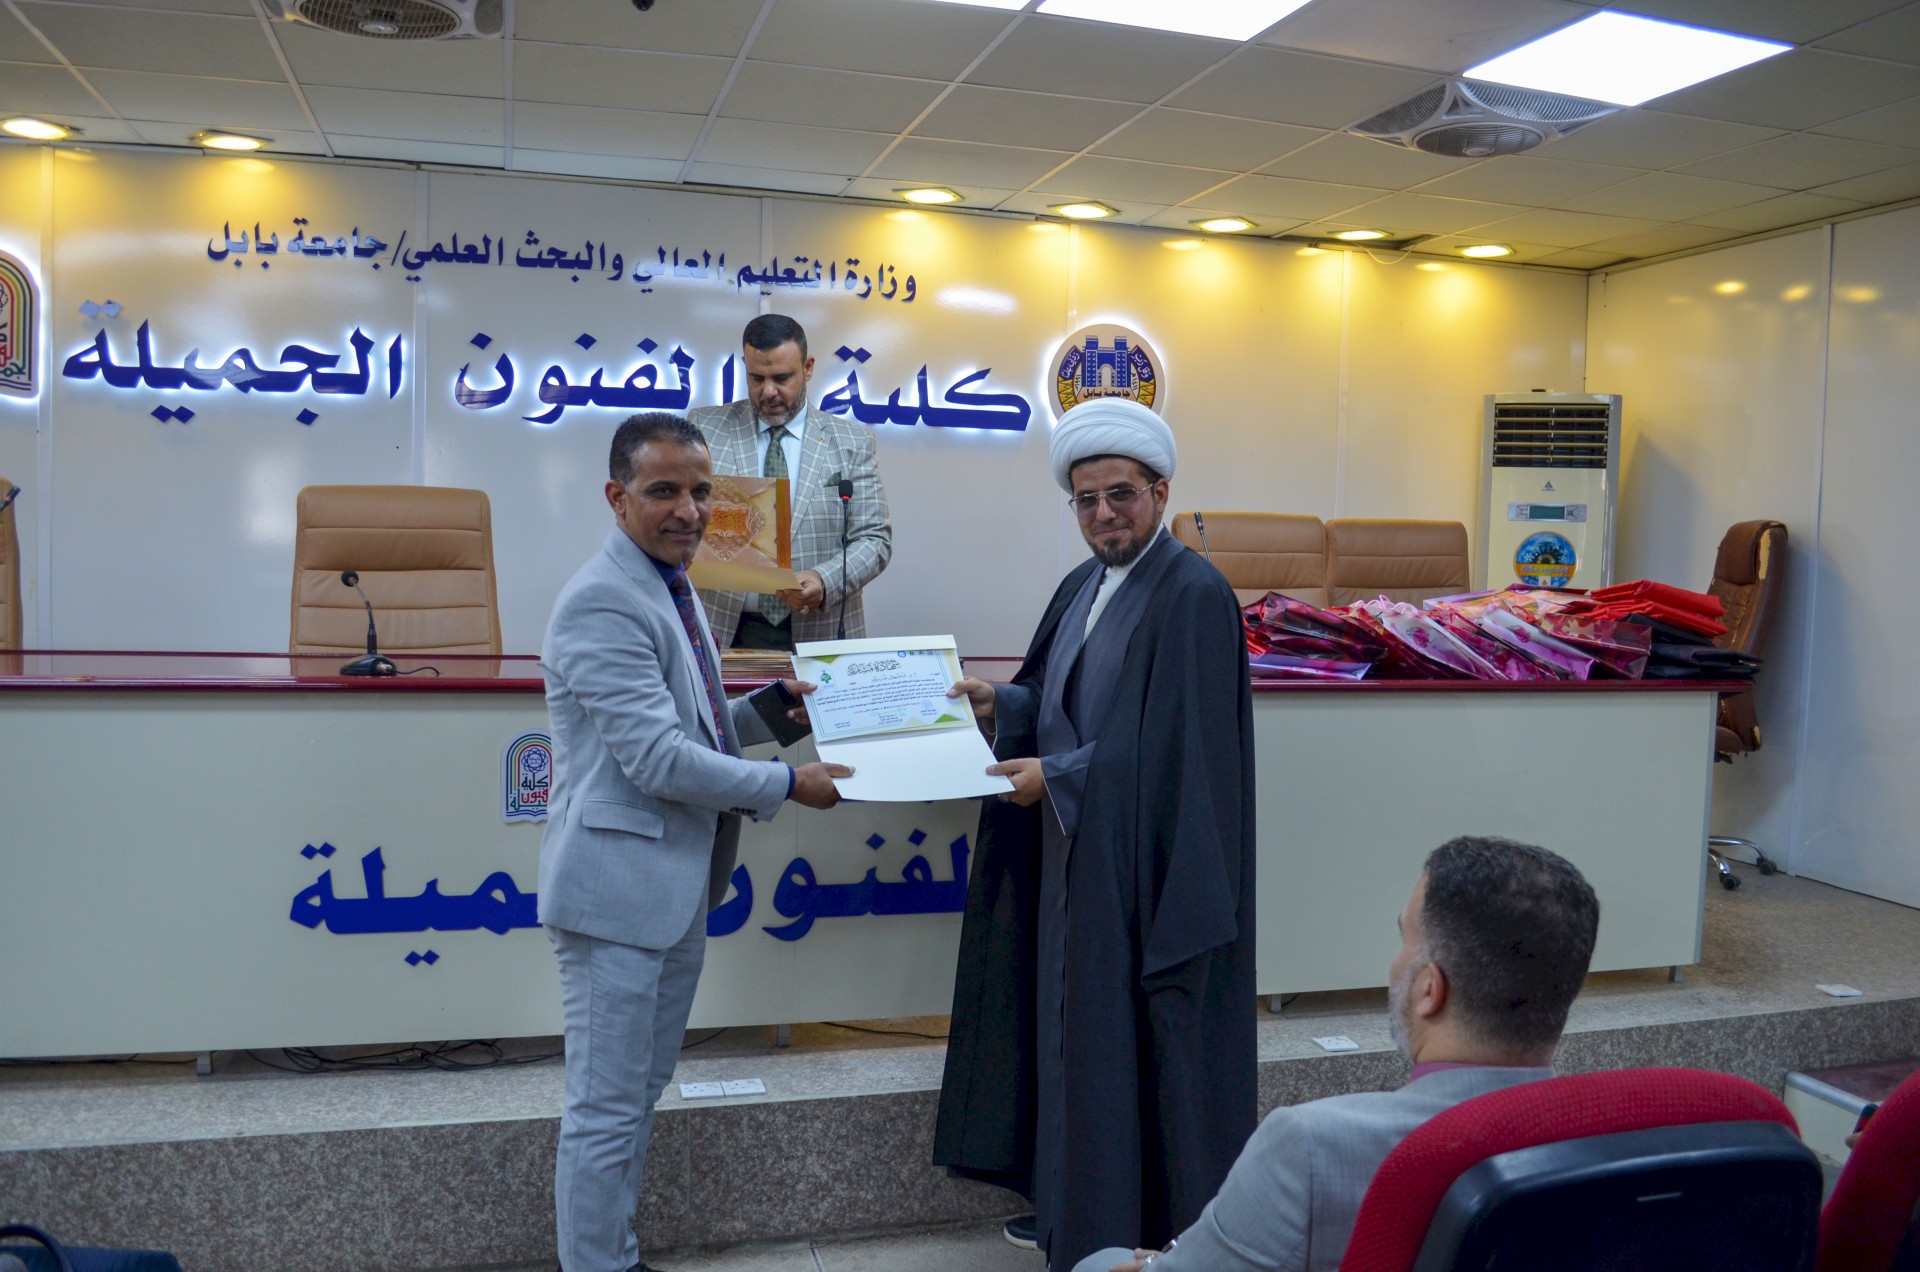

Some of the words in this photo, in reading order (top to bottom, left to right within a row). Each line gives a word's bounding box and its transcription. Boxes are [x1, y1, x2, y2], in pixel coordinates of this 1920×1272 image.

[207, 220, 280, 270] بابل
[515, 230, 624, 283] والبحث
[632, 245, 725, 294] العالي
[737, 255, 836, 295] التعليم
[844, 258, 917, 302] وزارة
[62, 299, 403, 426] الجميلة
[454, 332, 736, 425] الفنون
[1083, 388, 1102, 399] بابل
[1104, 388, 1130, 399] جامعة
[289, 842, 544, 967] ميلة
